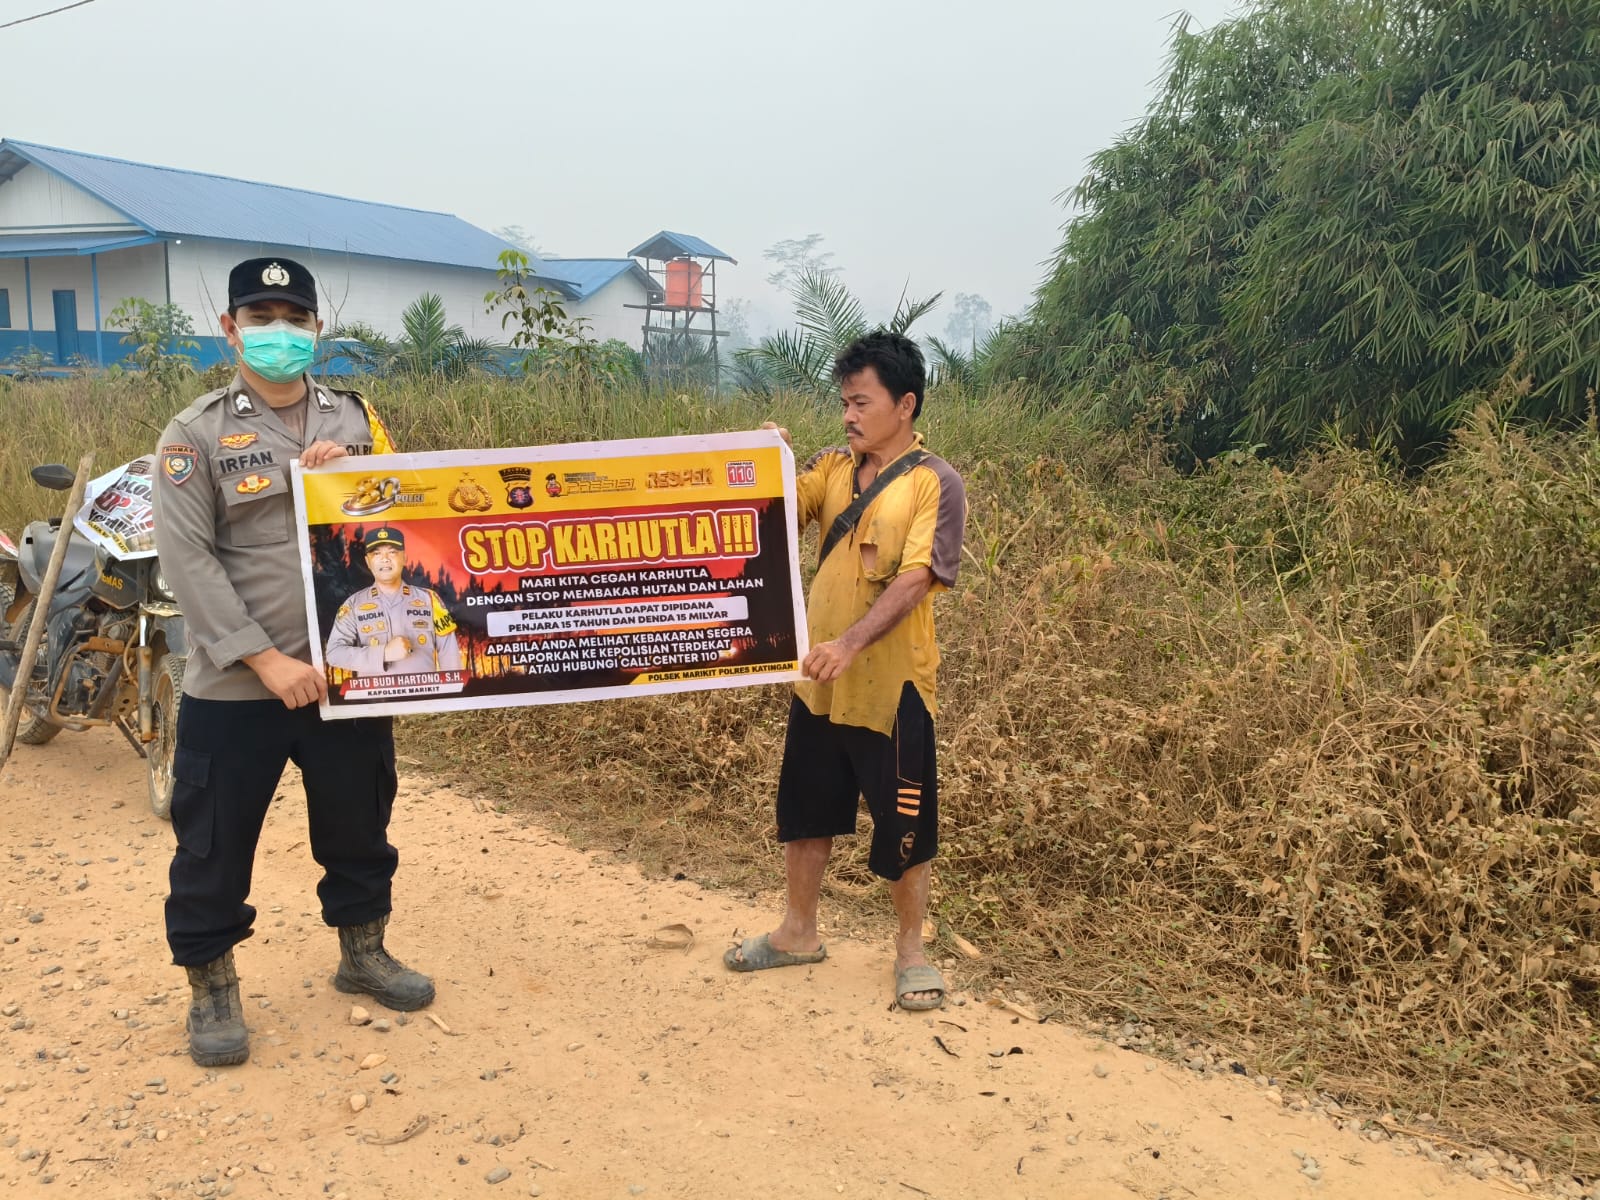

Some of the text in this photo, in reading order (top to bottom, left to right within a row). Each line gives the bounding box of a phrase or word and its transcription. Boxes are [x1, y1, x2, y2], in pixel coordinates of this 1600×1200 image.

[220, 451, 273, 474] IRFAN
[729, 467, 753, 484] 110
[465, 527, 546, 568] STOP
[553, 516, 717, 563] KARHUTLA
[521, 568, 709, 589] MARI KITA CEGAH KARHUTLA
[466, 578, 764, 606] DENGAN STOP MEMBAKAR HUTAN DAN LAHAN
[406, 609, 431, 617] POLRI
[508, 610, 728, 632] PENJARA 15 TAHUN DAN DENDA 15 MILYAR
[522, 601, 714, 620] PELAKU KARHUTLA DAPAT DIPIDANA
[487, 626, 753, 655] APABILA ANDA MELIHAT KEBAKARAN SEGERA
[512, 639, 731, 664] LAPORKAN KE KEPOLISIAN TERDEKAT
[528, 651, 718, 675] ATAU HUBUNGI CALL CENTER 110
[648, 663, 794, 682] POLSEK MARIKIT POLRES KATINGAN
[349, 672, 464, 689] IPTU BUDI HARTONO, S.H.
[367, 686, 440, 696] KAPOLSEK MARIKIT
